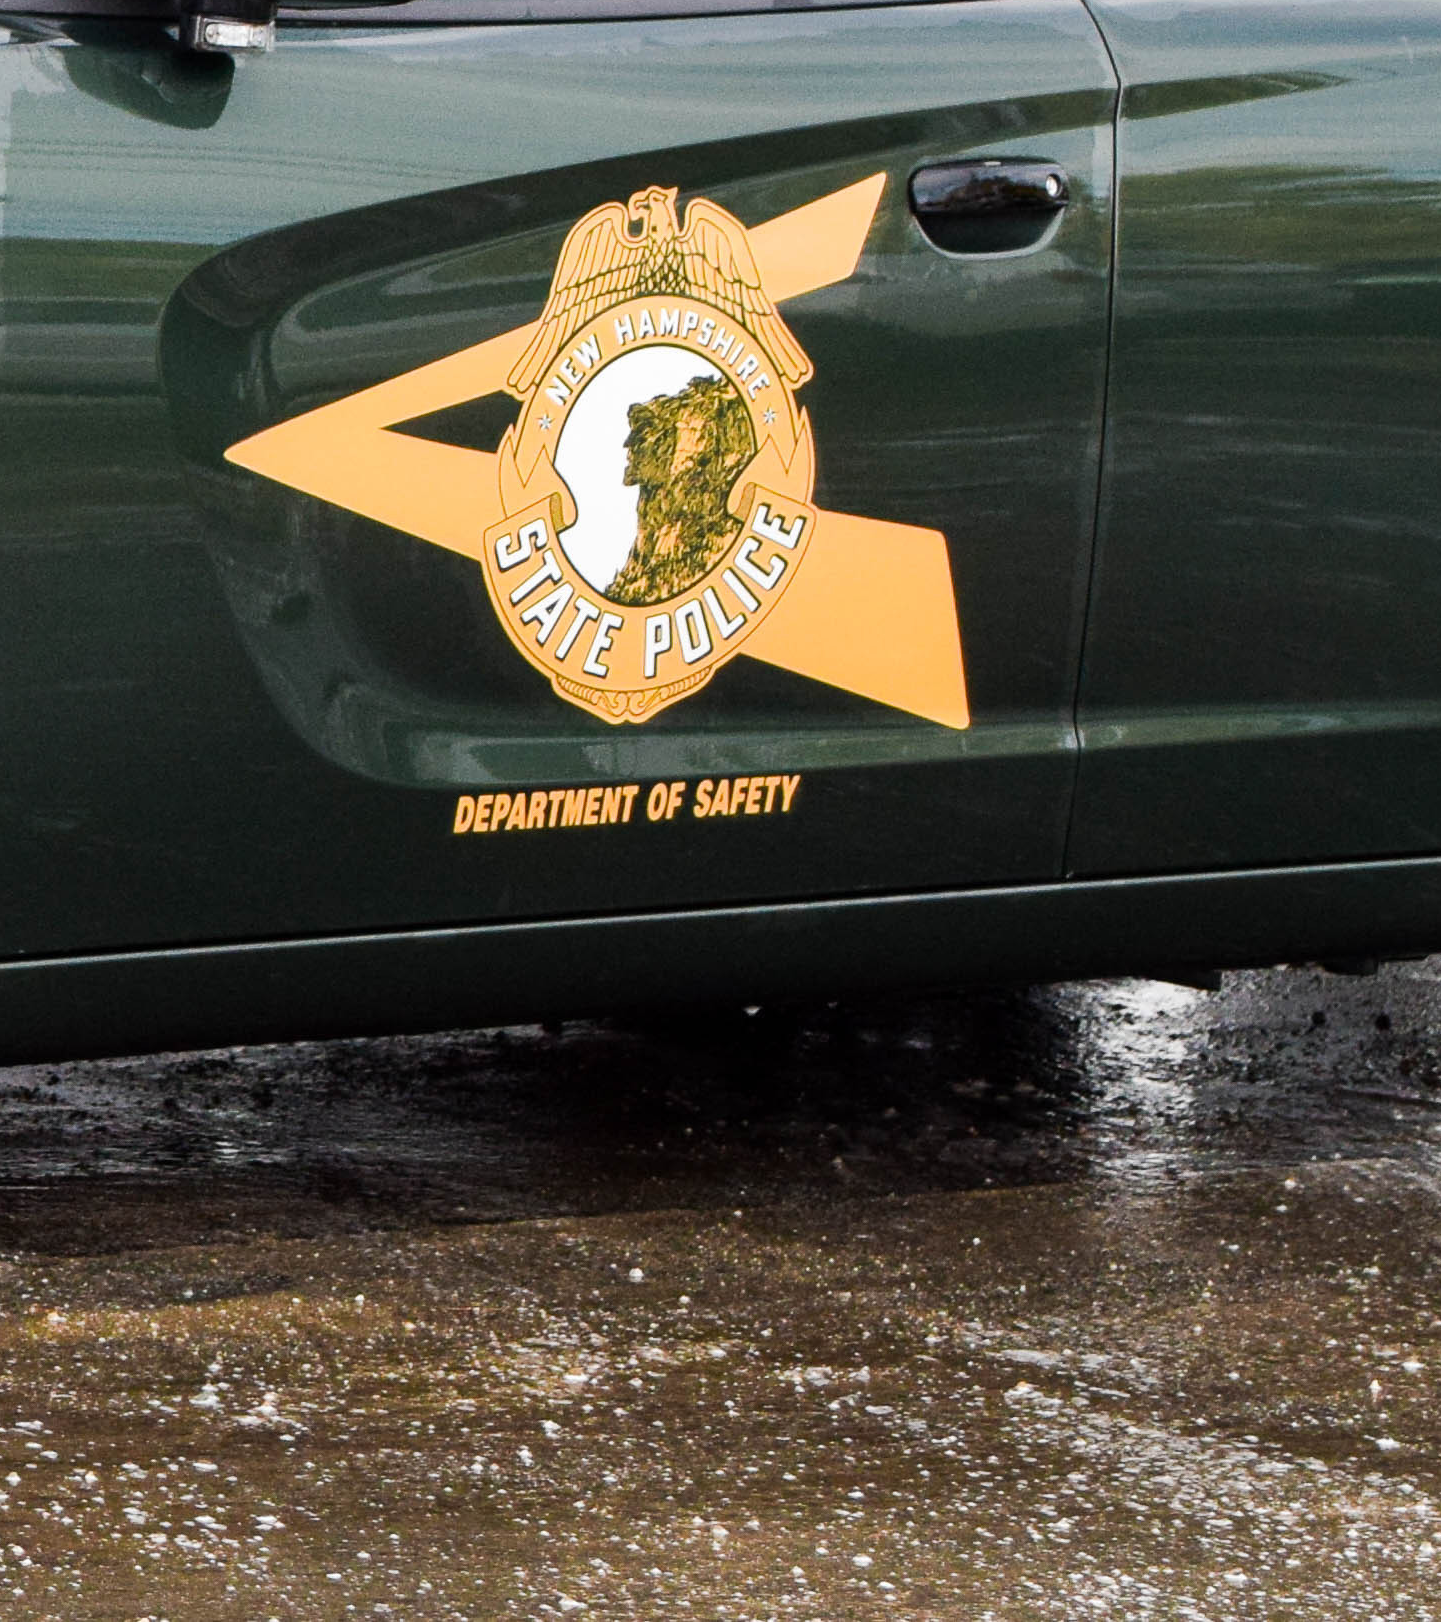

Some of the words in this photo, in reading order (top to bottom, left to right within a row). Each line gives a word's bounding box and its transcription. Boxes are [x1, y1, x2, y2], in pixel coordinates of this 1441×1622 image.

[545, 334, 603, 406] NEW
[614, 308, 770, 400] HAMPSHIRE
[495, 518, 623, 678] STATE
[644, 503, 806, 678] POLICE
[453, 784, 639, 834] DEPARTMENT
[647, 781, 686, 821] OF
[694, 775, 801, 817] SAFETY
